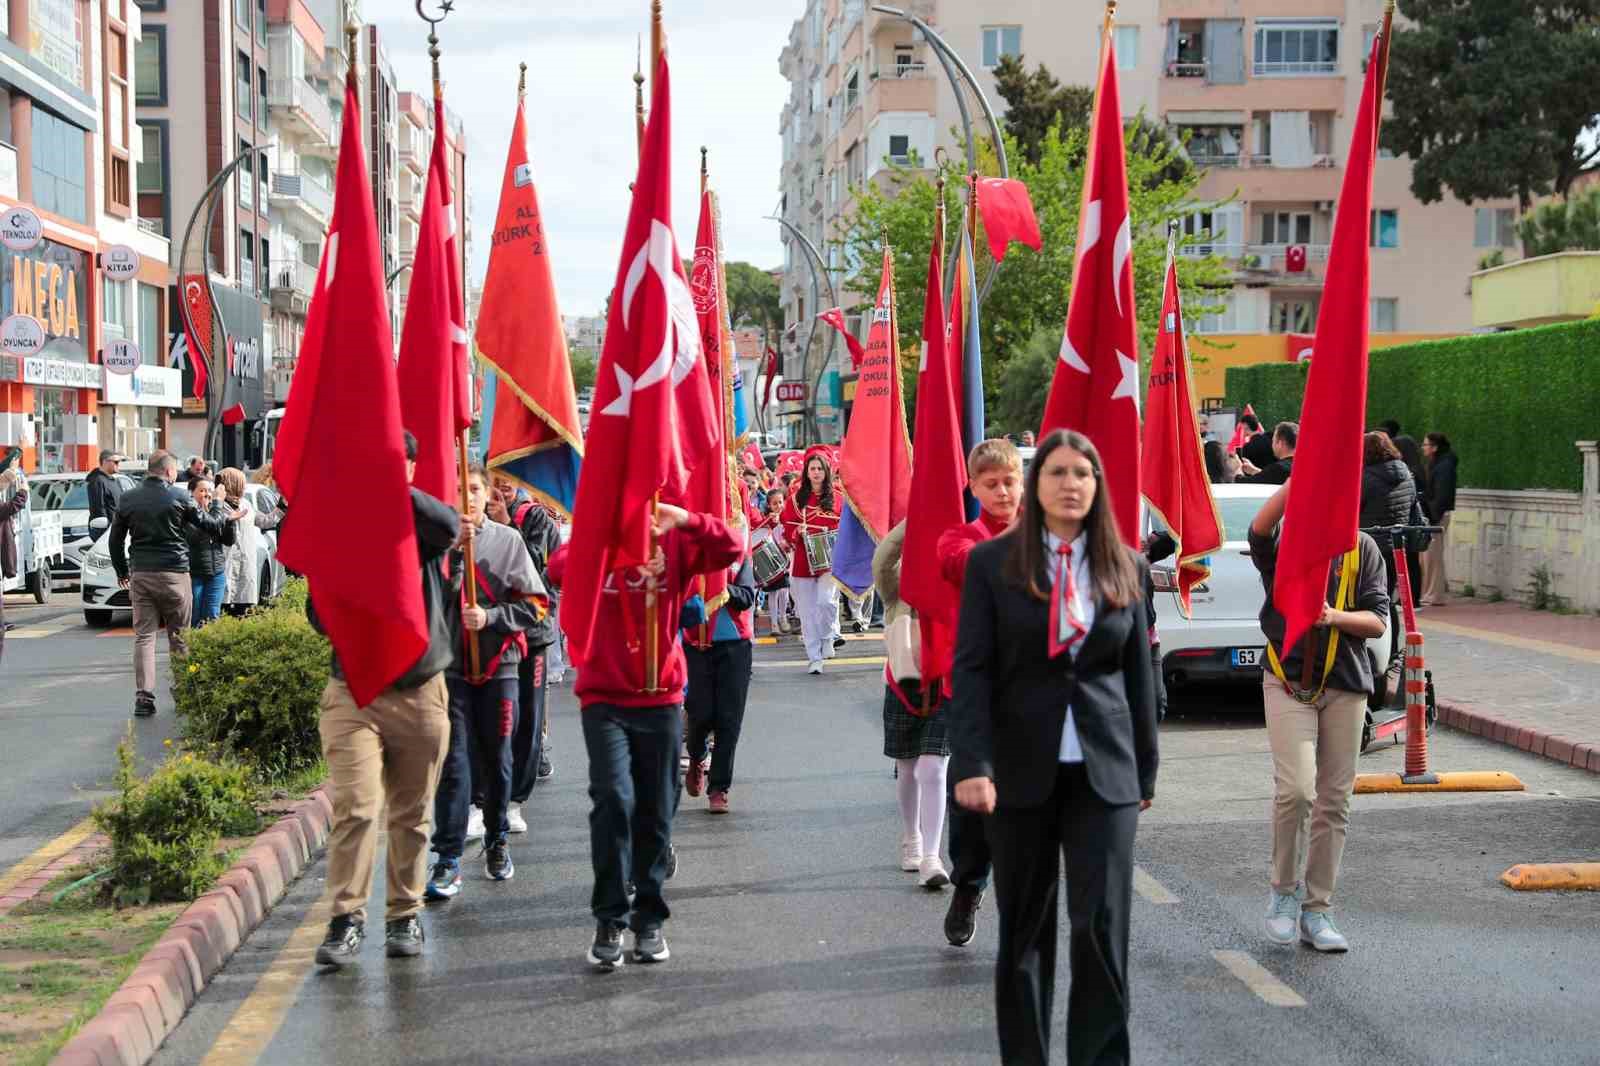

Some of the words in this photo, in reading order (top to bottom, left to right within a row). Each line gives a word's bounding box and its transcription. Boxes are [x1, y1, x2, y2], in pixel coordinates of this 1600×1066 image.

[106, 262, 134, 272] KİTAP
[13, 255, 80, 338] MEGA
[3, 338, 37, 347] OYUNCAK
[1239, 650, 1255, 664] 63
